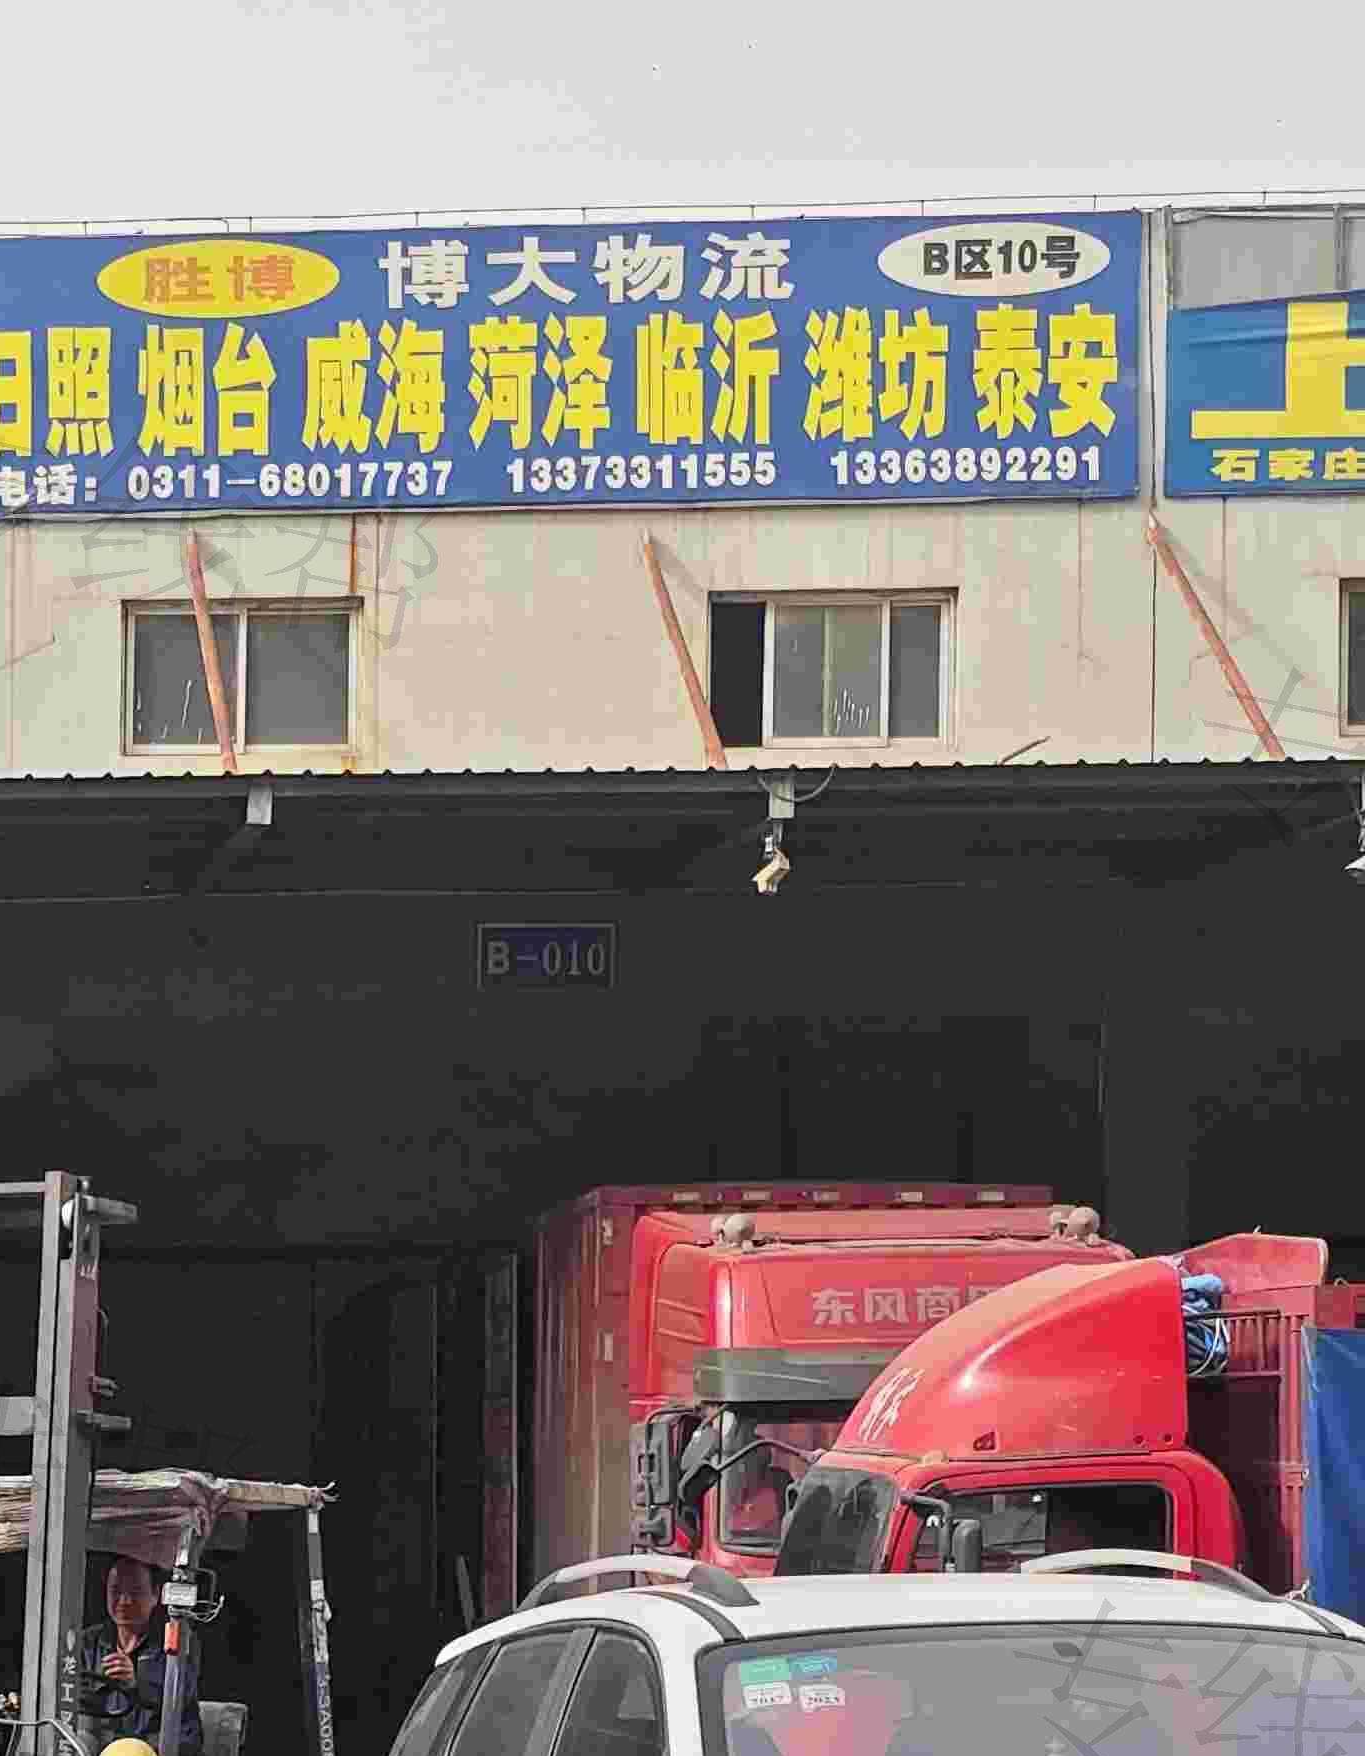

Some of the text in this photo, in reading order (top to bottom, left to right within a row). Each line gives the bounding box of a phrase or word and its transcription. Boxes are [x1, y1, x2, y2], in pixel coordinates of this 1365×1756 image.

[143, 254, 297, 304] 胜博
[378, 232, 1082, 310] 博大物流 B区10号
[138, 322, 277, 458] 烟台
[301, 319, 448, 456] 威海
[468, 312, 613, 451] 菏泽
[636, 309, 781, 448] 临沂
[803, 305, 950, 444] 潍坊
[972, 302, 1119, 441] 泰安
[127, 460, 453, 502] 0311-68017737
[506, 450, 777, 493] 13373311555
[830, 445, 1101, 486] 13363892291
[1210, 447, 1365, 482] 石家庄
[485, 939, 605, 976] B-010
